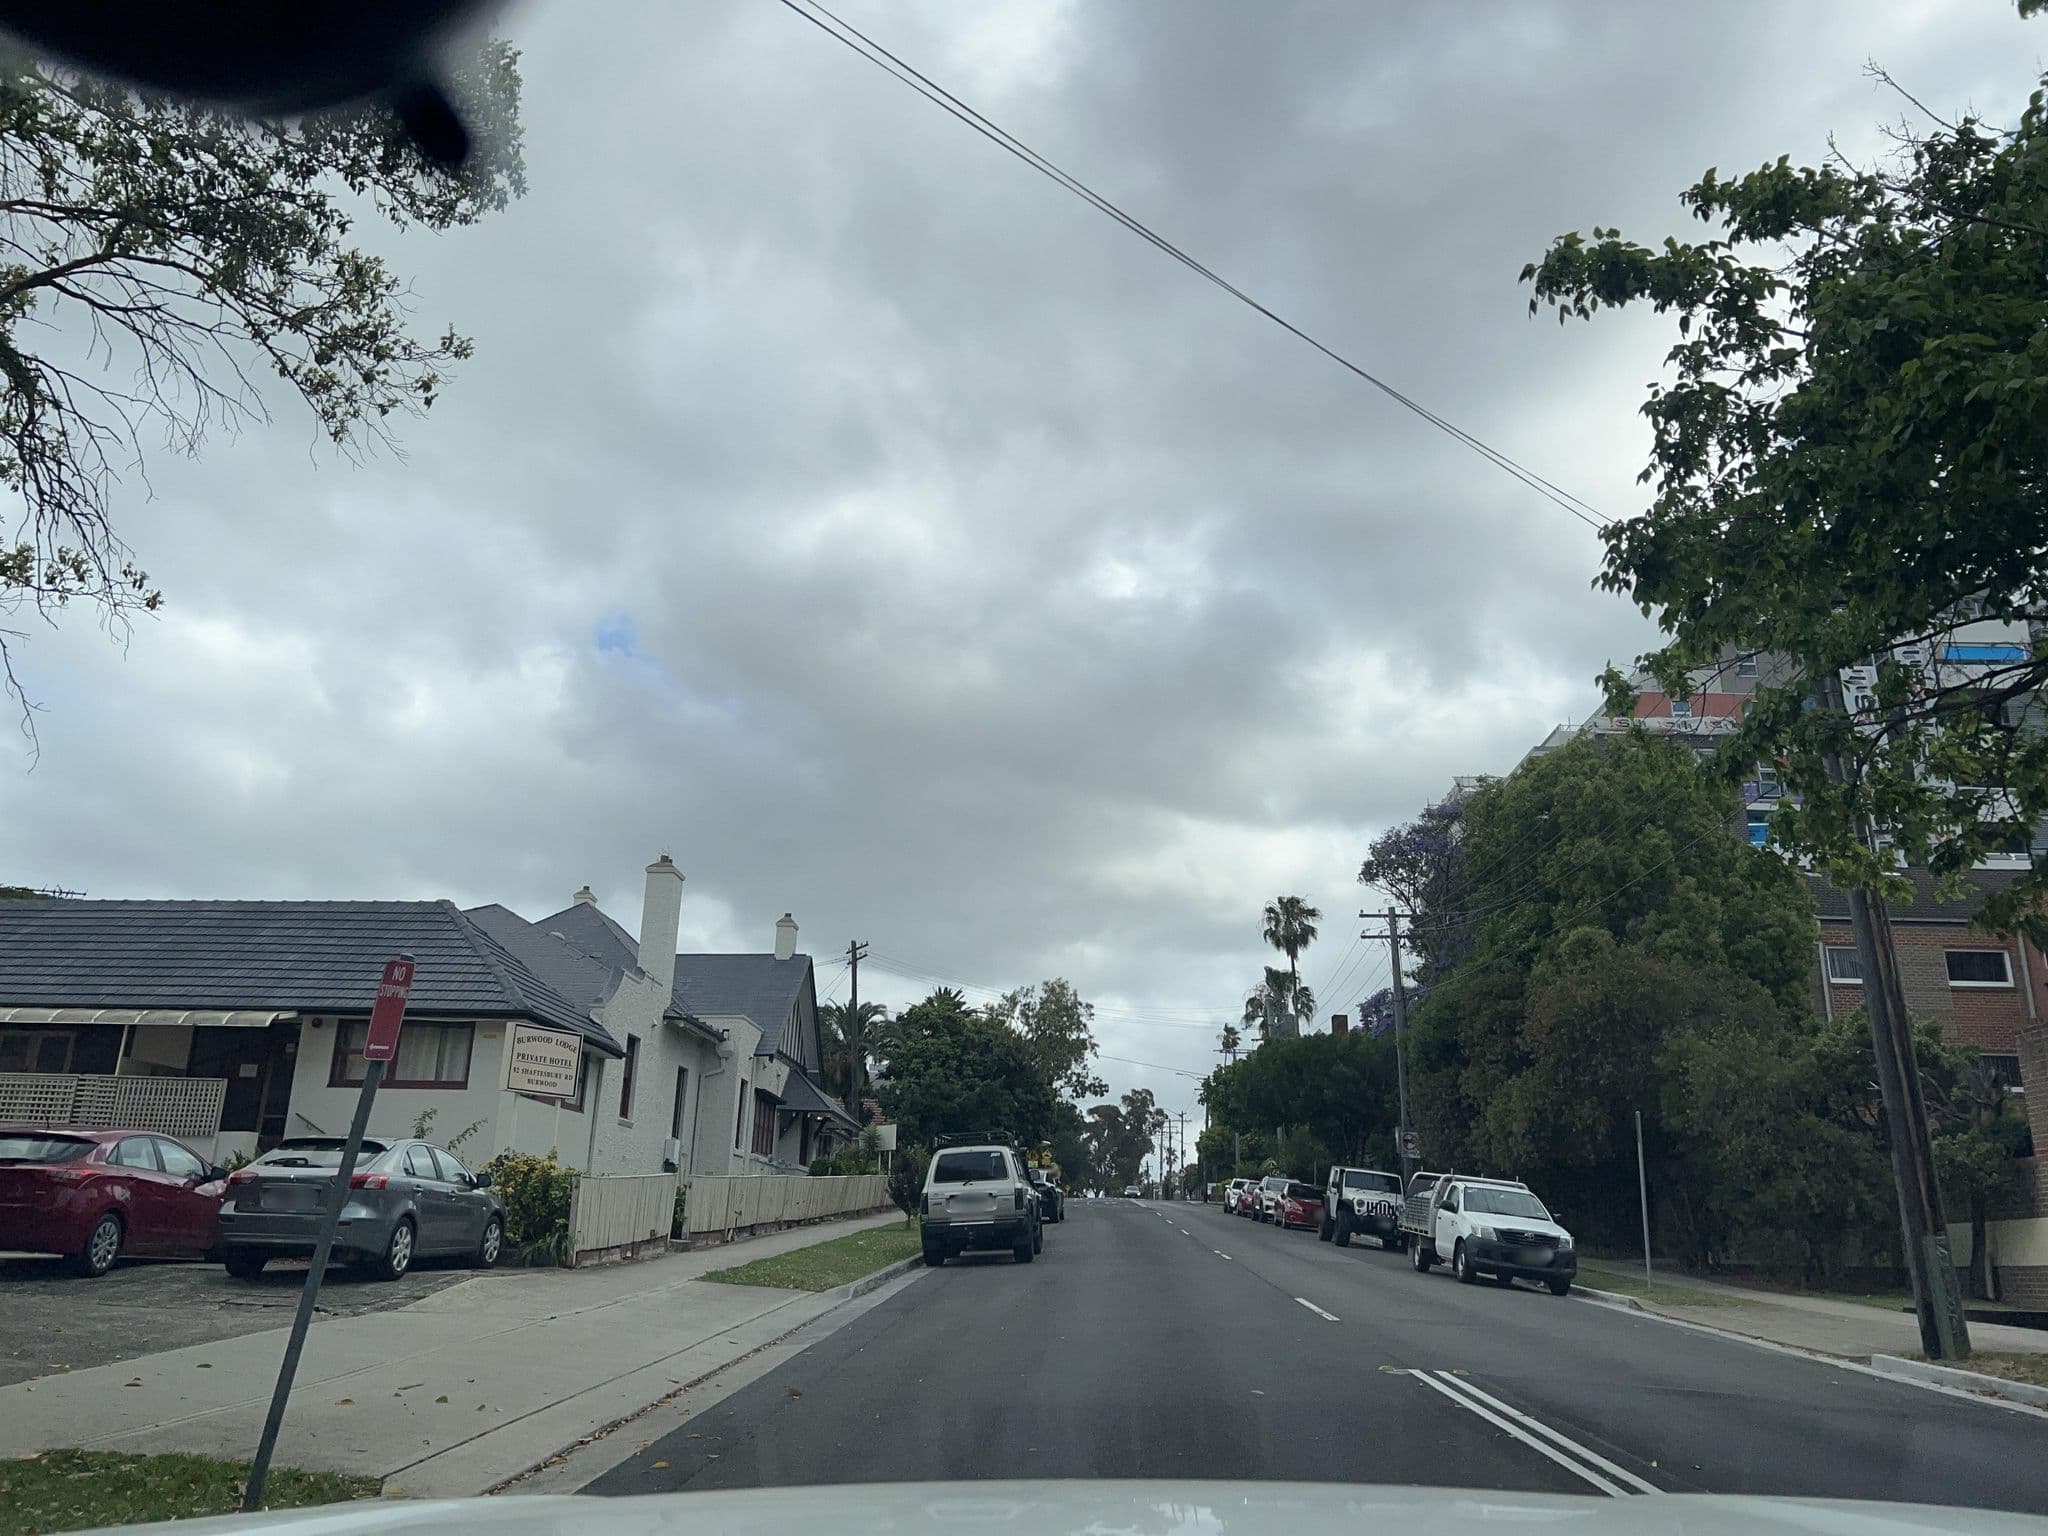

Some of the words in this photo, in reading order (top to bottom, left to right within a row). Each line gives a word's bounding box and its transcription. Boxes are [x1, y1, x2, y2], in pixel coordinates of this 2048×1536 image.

[391, 966, 407, 982] NO
[516, 1035, 553, 1045] BURWOOD
[555, 1038, 577, 1054] LODGE
[516, 1052, 548, 1064] PRIVATE
[549, 1057, 573, 1067] HOTEL
[527, 1078, 558, 1088] BURWOOD
